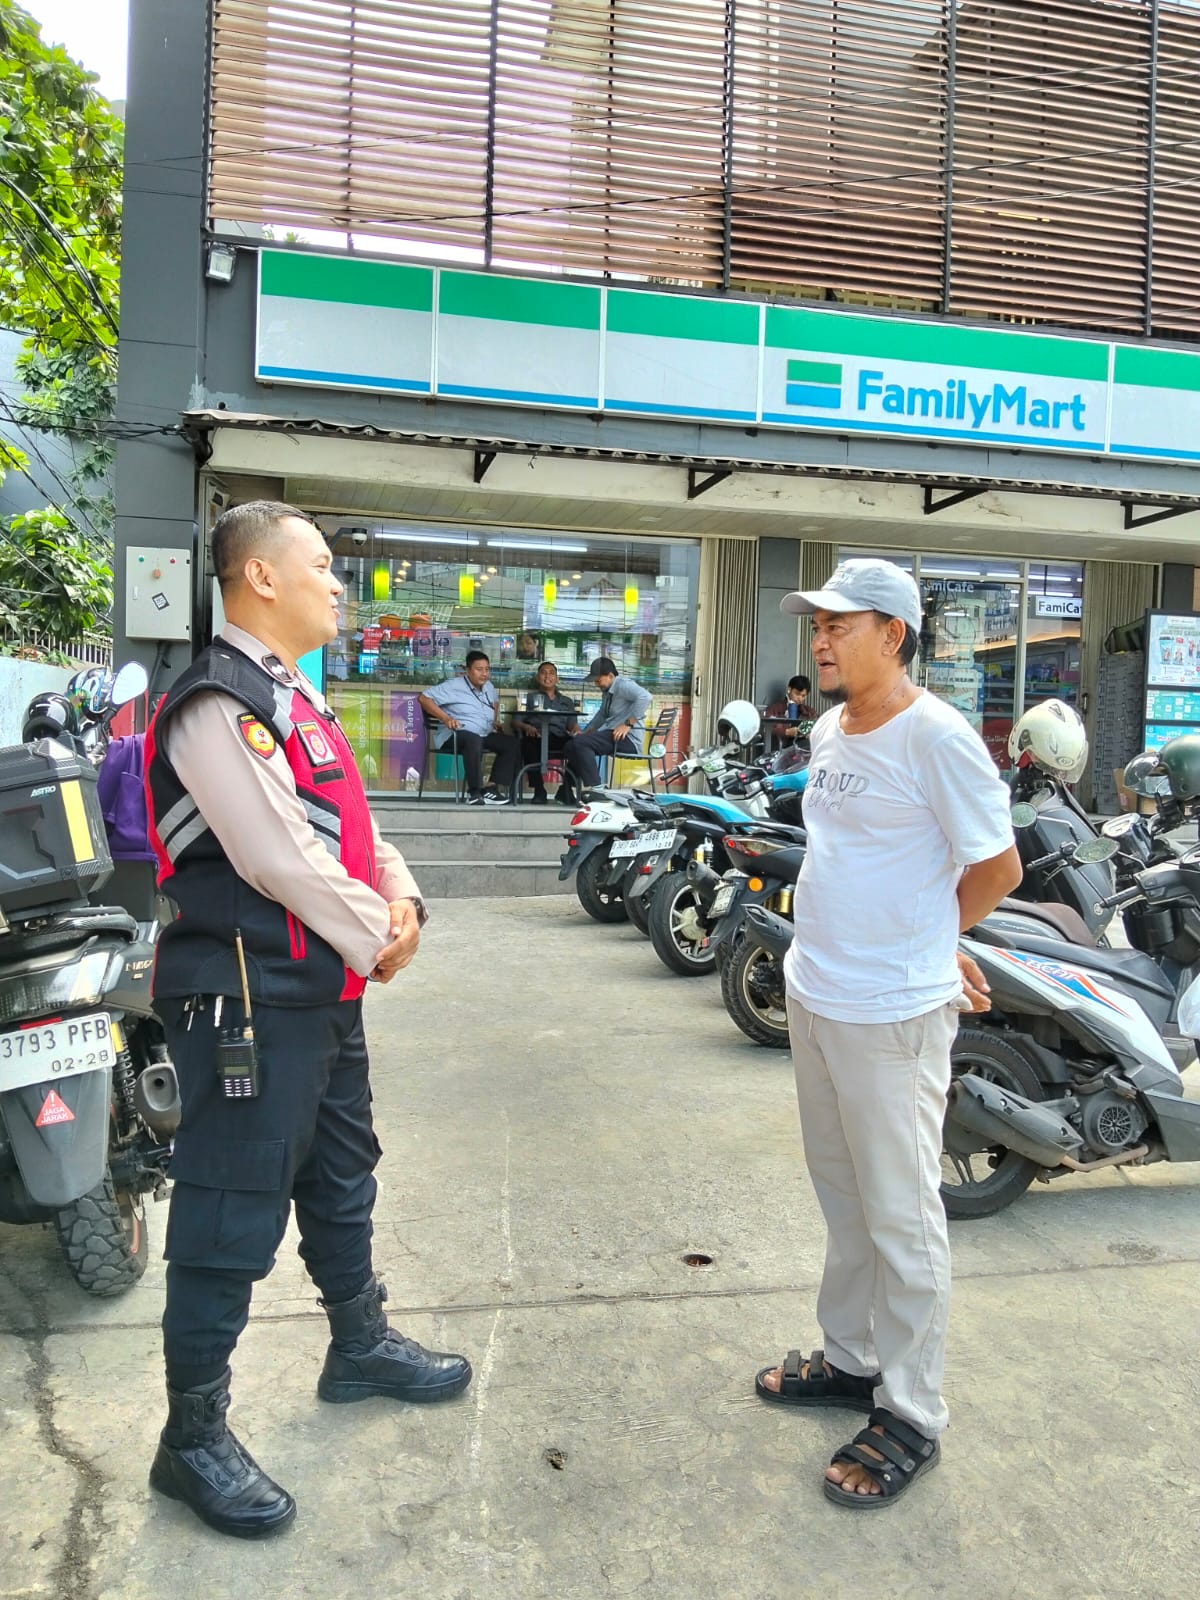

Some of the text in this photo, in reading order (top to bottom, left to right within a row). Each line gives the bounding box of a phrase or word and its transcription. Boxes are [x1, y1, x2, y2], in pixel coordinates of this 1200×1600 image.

[857, 369, 1086, 431] FamilyMart
[406, 700, 414, 727] GRAPE
[31, 785, 56, 797] ASTRO
[1, 1019, 108, 1058] 3793 PFB
[41, 1113, 69, 1124] JARAK
[43, 1106, 65, 1116] JAGA
